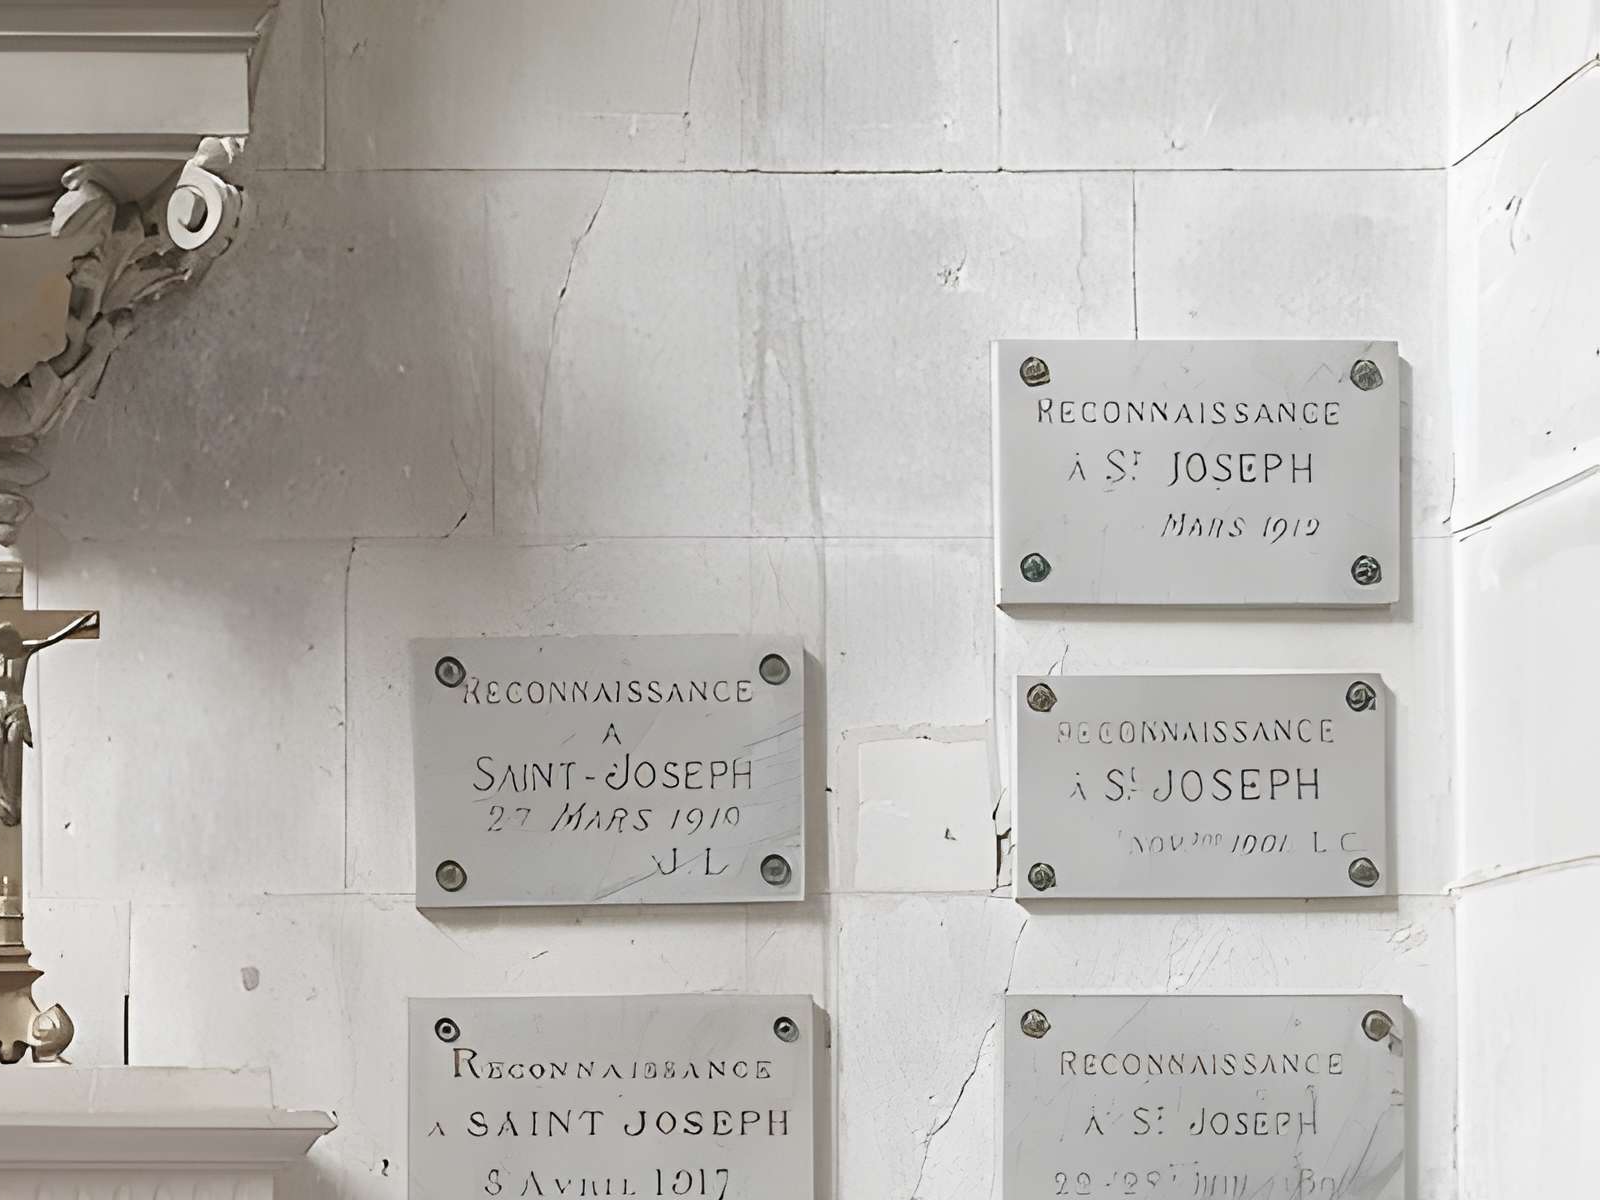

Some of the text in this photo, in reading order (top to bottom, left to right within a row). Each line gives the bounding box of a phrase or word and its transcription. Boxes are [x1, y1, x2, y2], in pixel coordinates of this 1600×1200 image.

[1037, 398, 1340, 426] RECONNAISSANCE
[1167, 452, 1313, 487] JOSEPH
[463, 677, 753, 704] RECONNAISSANCE
[601, 722, 622, 745] A
[1057, 718, 1336, 745] RECONNAISSANCE
[1152, 767, 1320, 802] JOSEPH
[550, 802, 653, 833] MARS
[1060, 1050, 1344, 1077] RECONNAISSANCE
[467, 1110, 606, 1138] SAINT
[623, 1109, 790, 1138] JOSEPH
[1189, 1107, 1318, 1137] JOSEPH
